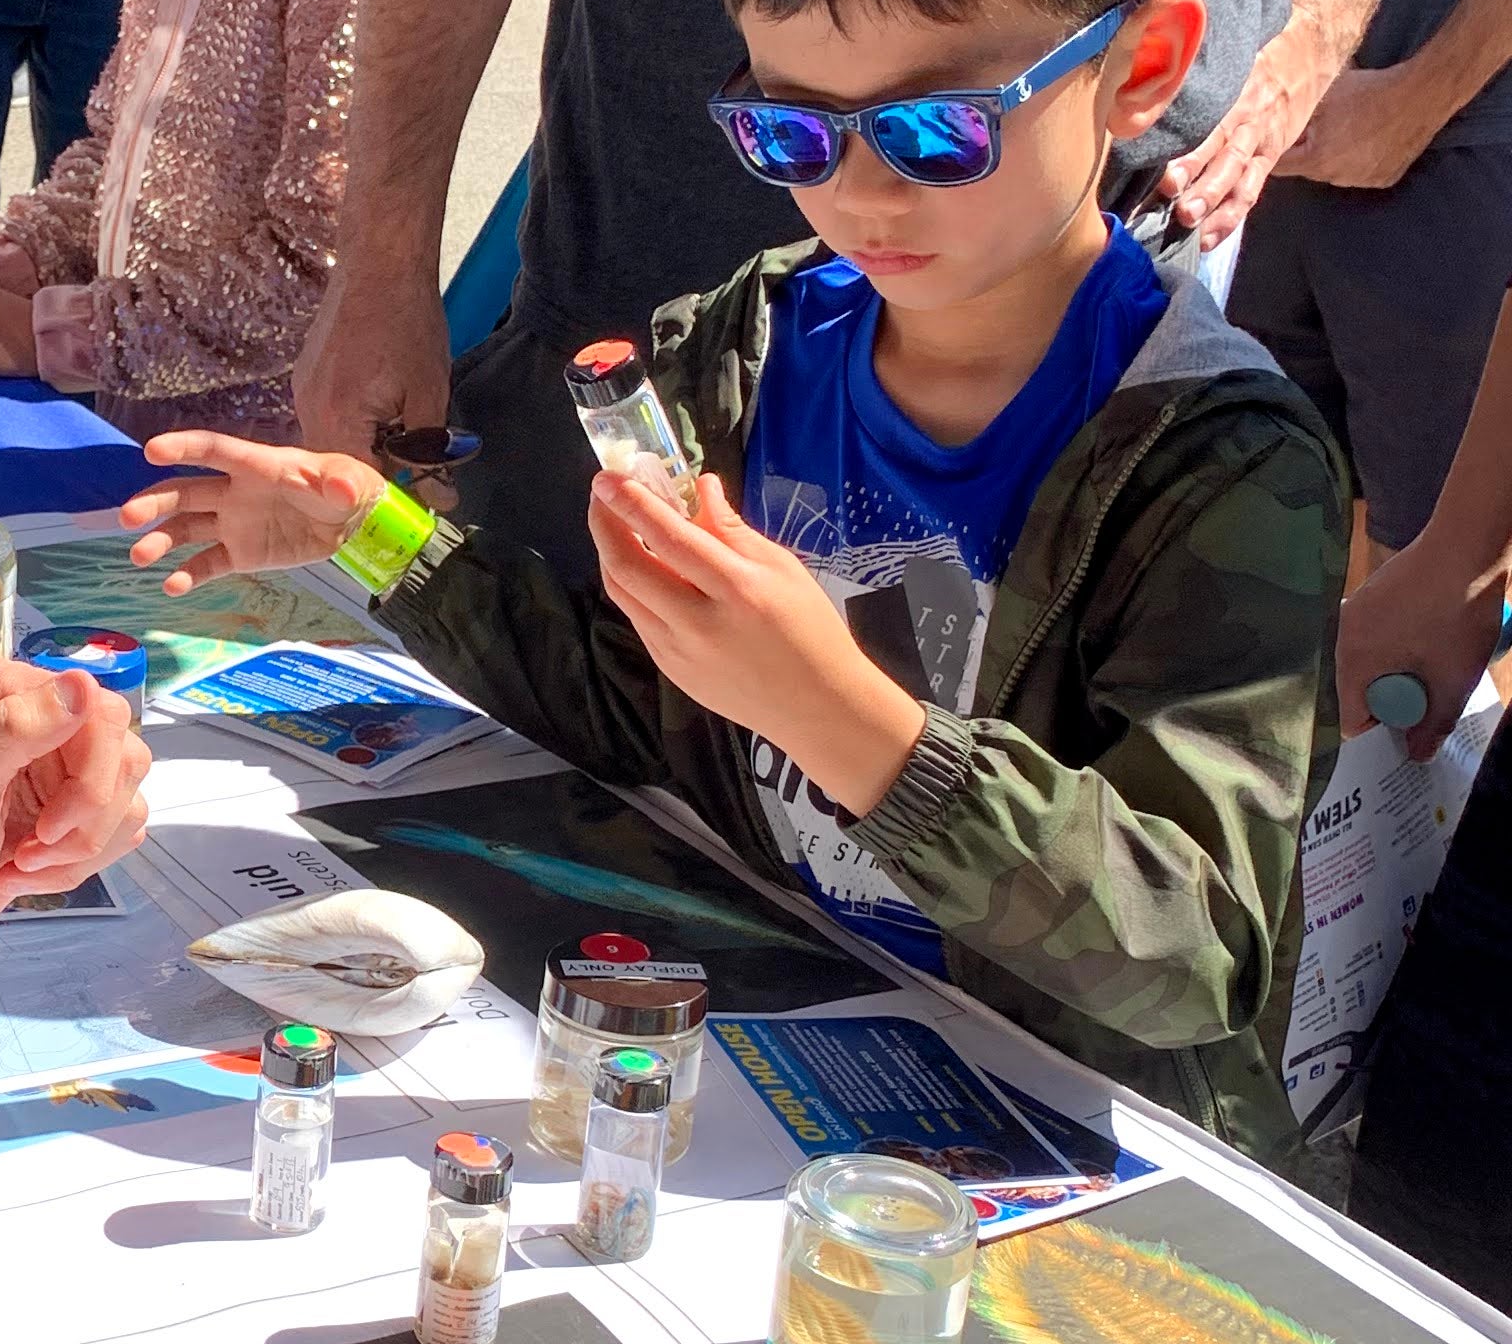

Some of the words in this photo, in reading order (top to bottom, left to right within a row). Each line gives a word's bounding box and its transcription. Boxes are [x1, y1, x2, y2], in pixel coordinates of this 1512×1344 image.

[255, 716, 334, 746] OPEN
[1313, 786, 1360, 835] STEM
[233, 863, 305, 900] uid
[1315, 914, 1327, 928] IN
[1329, 893, 1364, 921] WOMEN
[567, 962, 615, 972] ONLY
[623, 964, 699, 975] DISPLAY
[712, 1022, 786, 1084] HOUSE
[762, 1088, 832, 1141] OPEN
